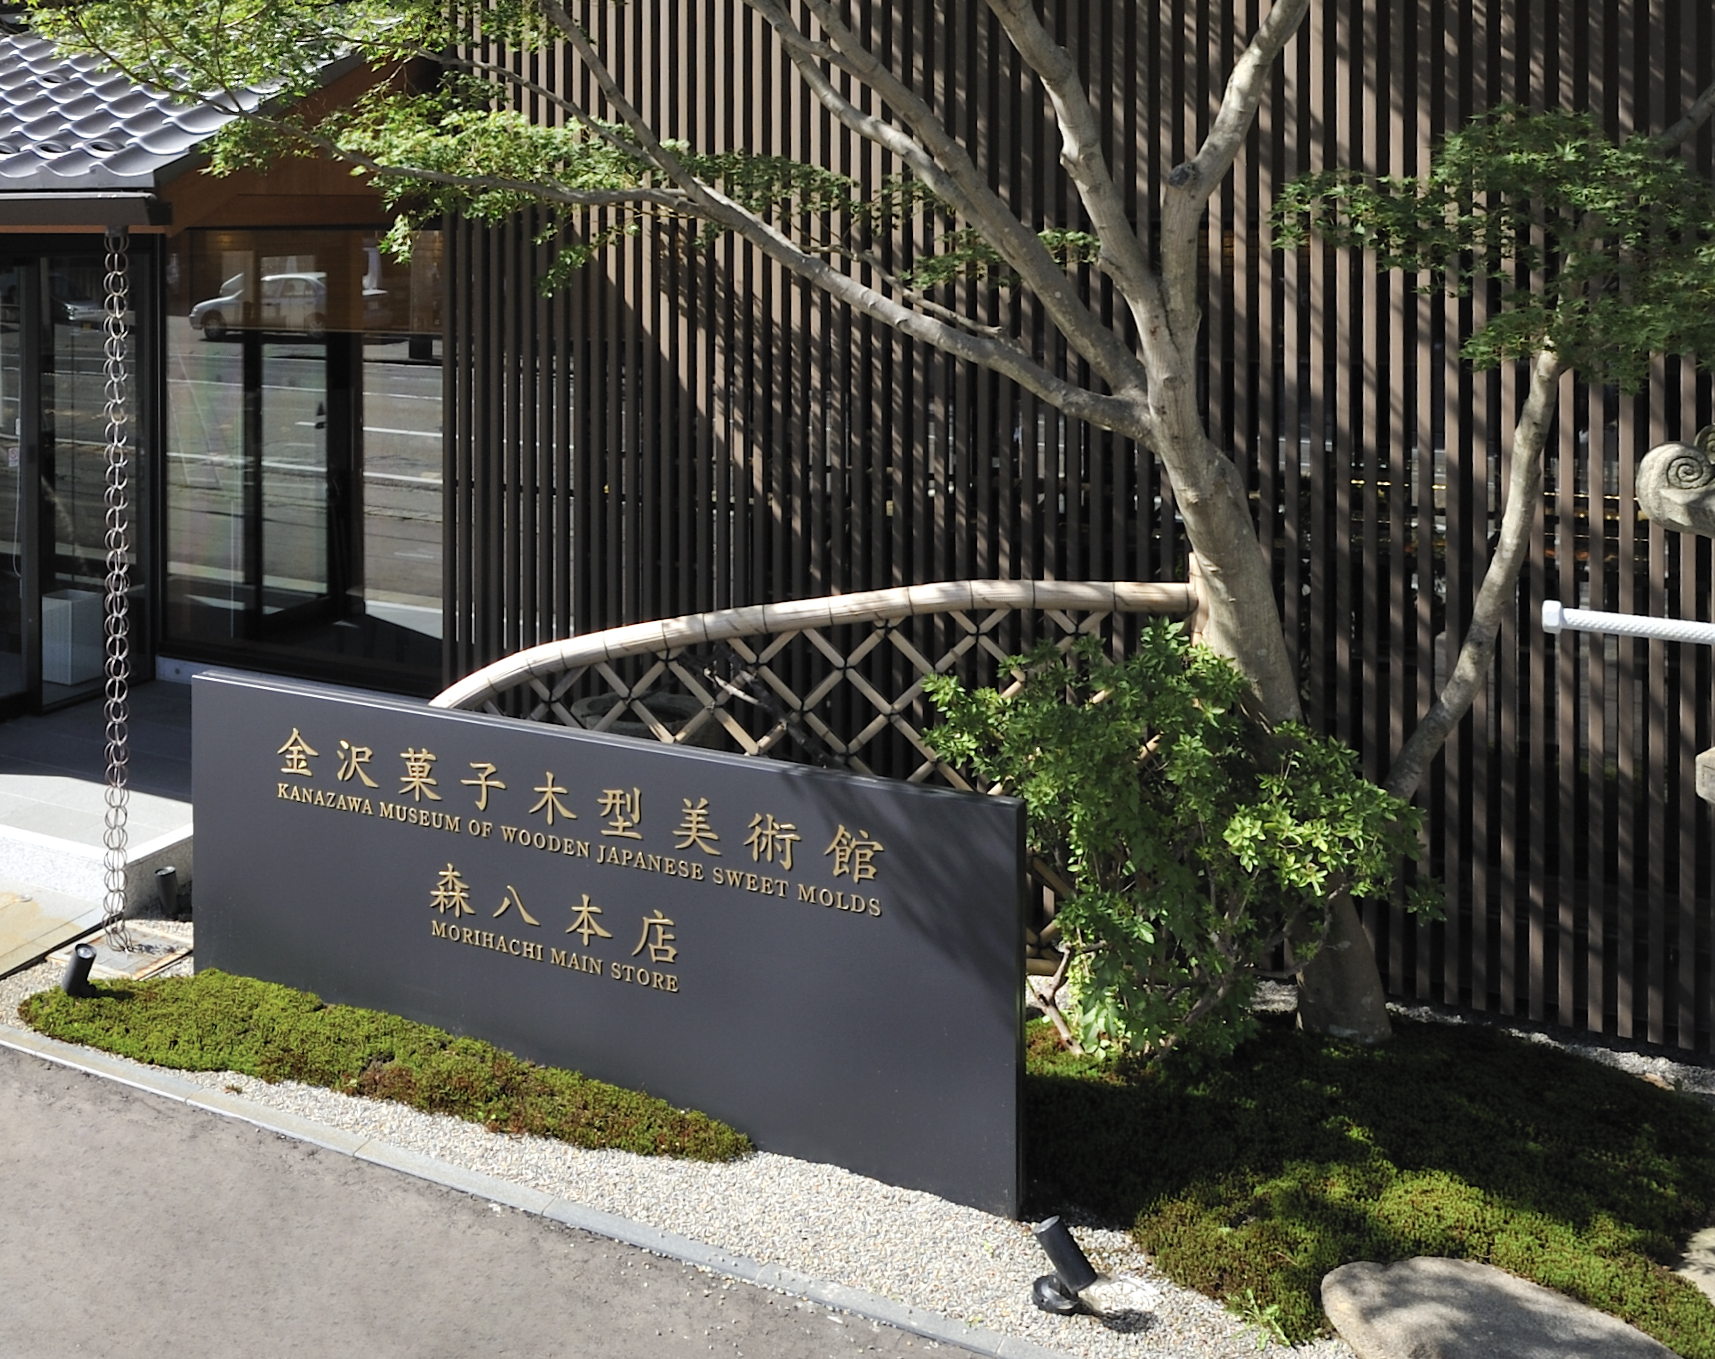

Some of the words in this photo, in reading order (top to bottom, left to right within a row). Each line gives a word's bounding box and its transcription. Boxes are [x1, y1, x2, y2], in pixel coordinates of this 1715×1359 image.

[276, 727, 885, 884] 金沢菓子木型美術館
[277, 782, 375, 816] KANAZAWA
[379, 801, 462, 833] MUSEUM
[468, 819, 494, 839] OF
[500, 825, 591, 859] WOODEN
[596, 844, 706, 882] JAPANESE
[712, 866, 790, 899] SWEET
[797, 882, 883, 918] MOLDS
[429, 863, 679, 964] 森八本店
[431, 919, 544, 962] MORIHACHI
[550, 947, 604, 976] MAIN
[610, 962, 681, 993] STORE
